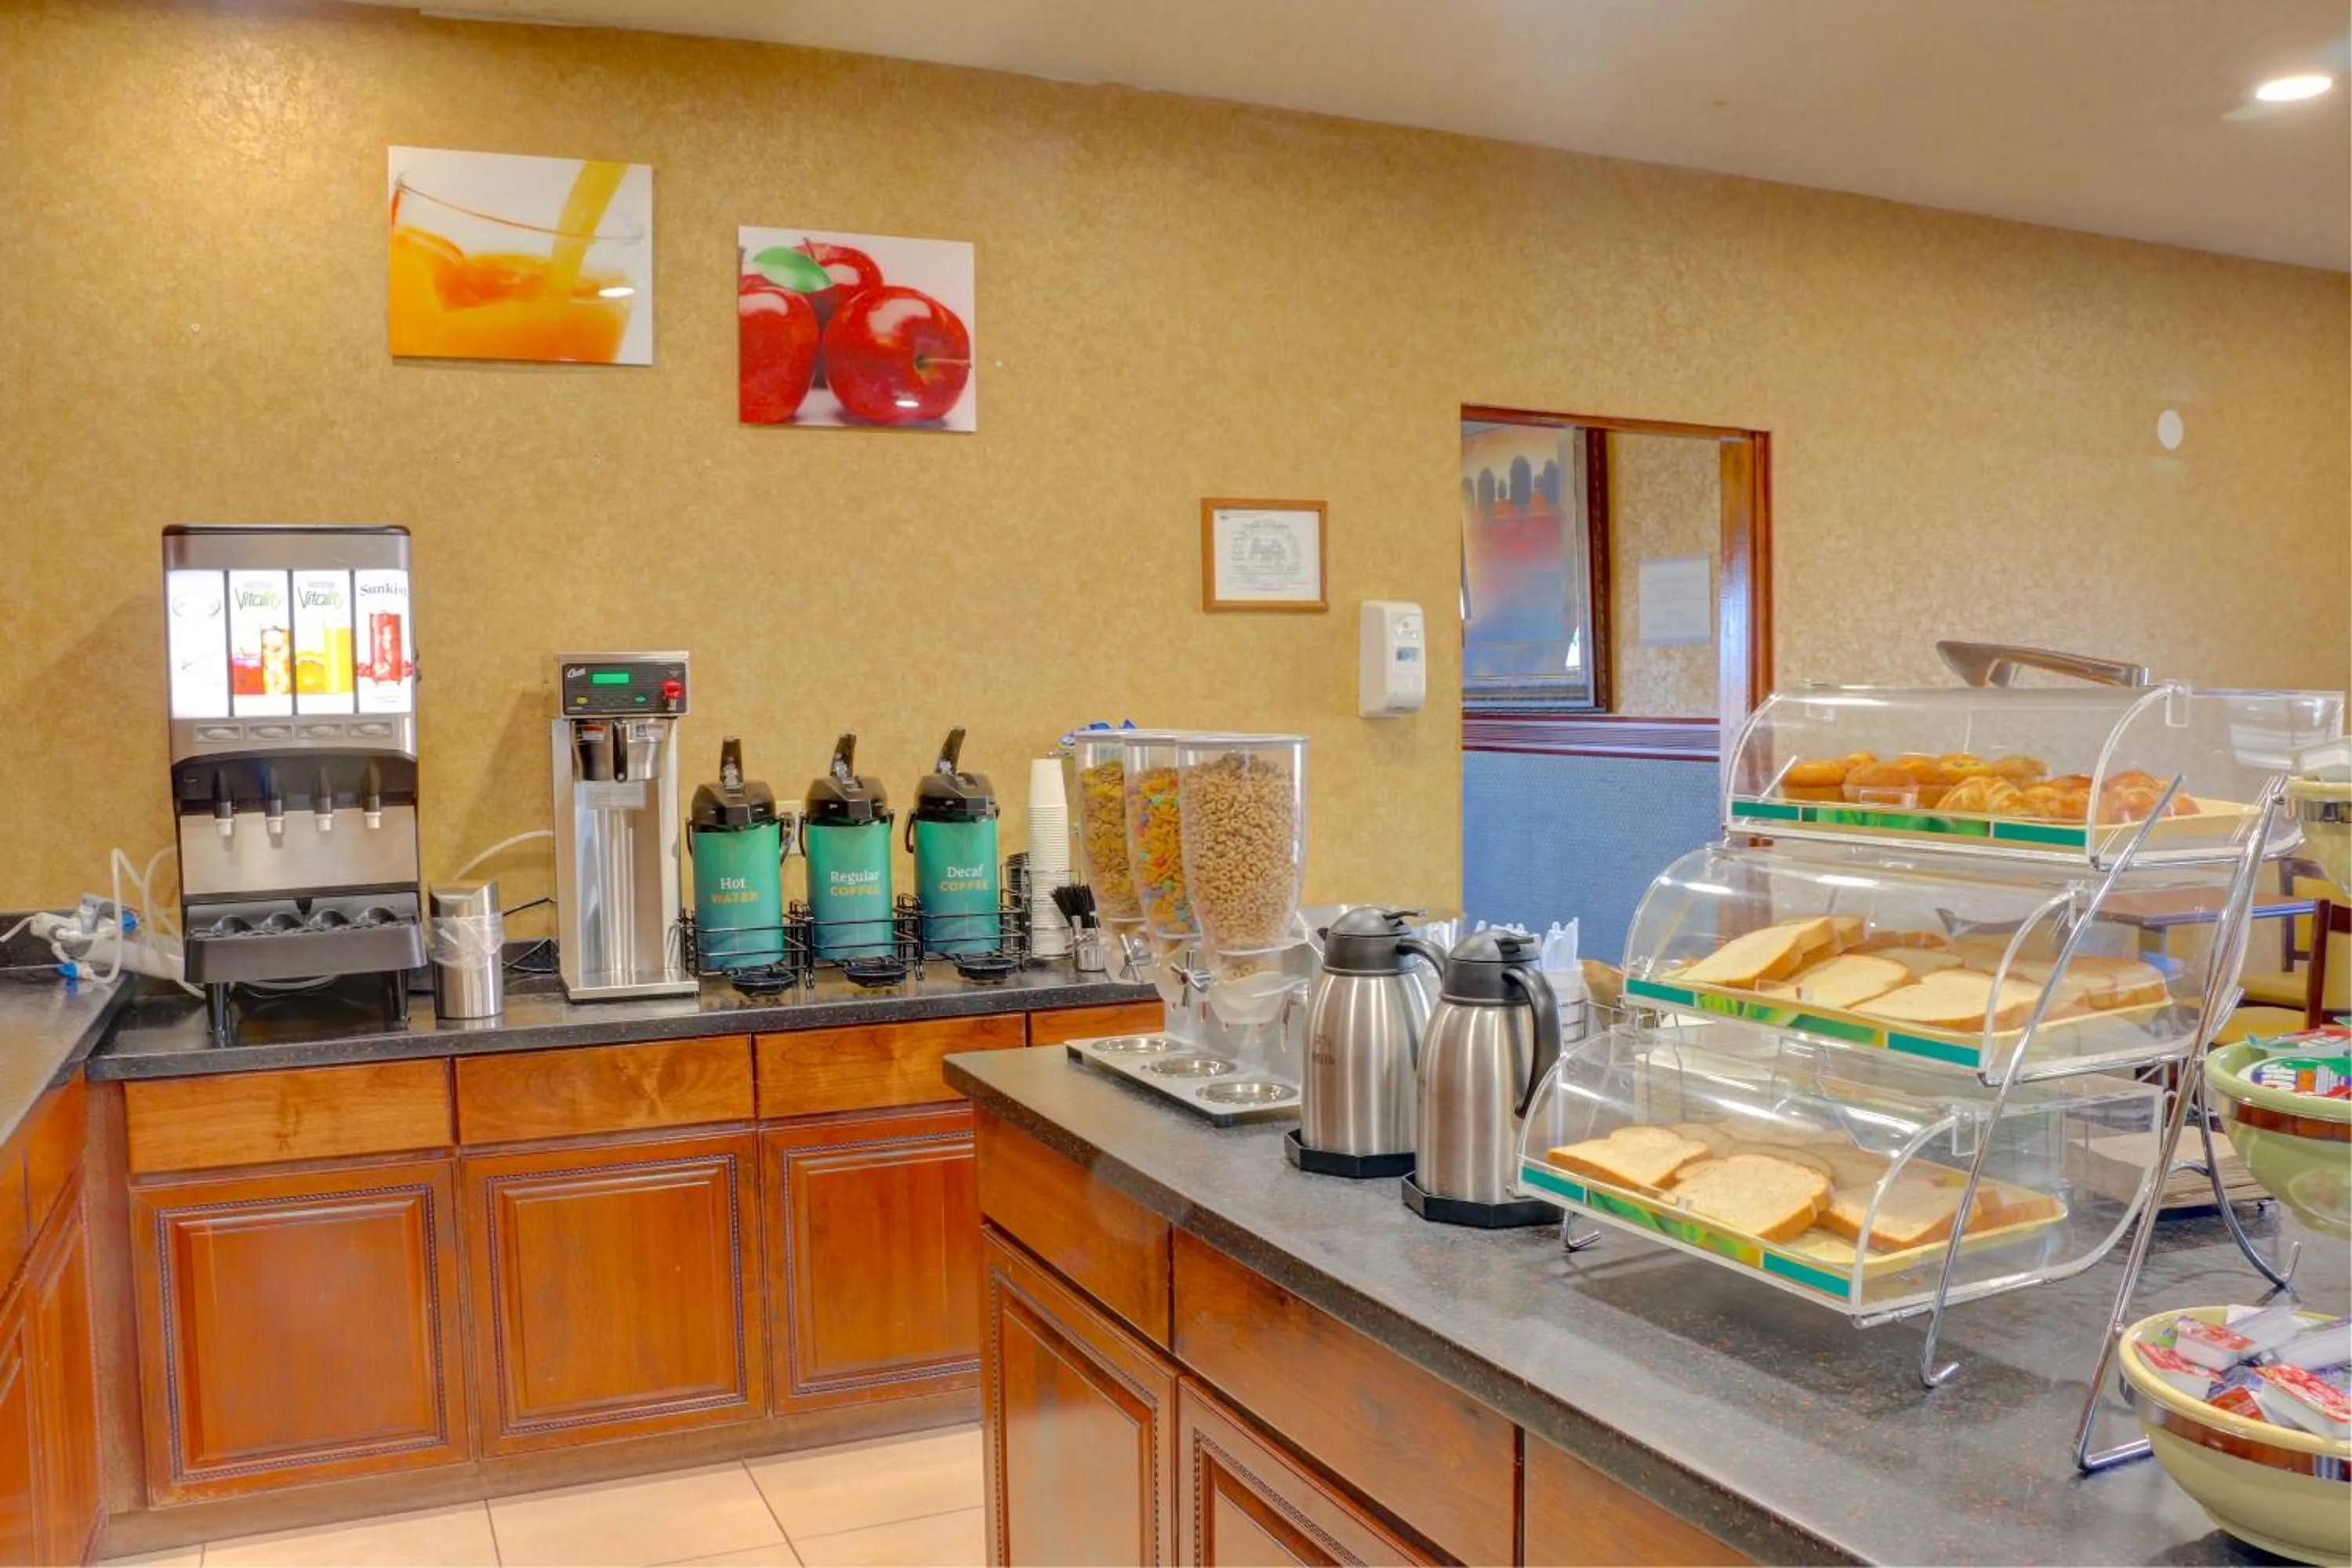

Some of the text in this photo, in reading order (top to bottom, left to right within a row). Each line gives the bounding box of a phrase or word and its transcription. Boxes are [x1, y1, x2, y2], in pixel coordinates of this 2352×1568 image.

[234, 586, 282, 611] Vitality
[297, 586, 344, 610] Vitality
[830, 869, 879, 885] Regular
[946, 863, 984, 878] Decaf
[720, 877, 747, 890] Hot
[940, 880, 989, 891] COFFEE
[710, 891, 760, 904] WATER
[829, 886, 880, 897] COFFEE
